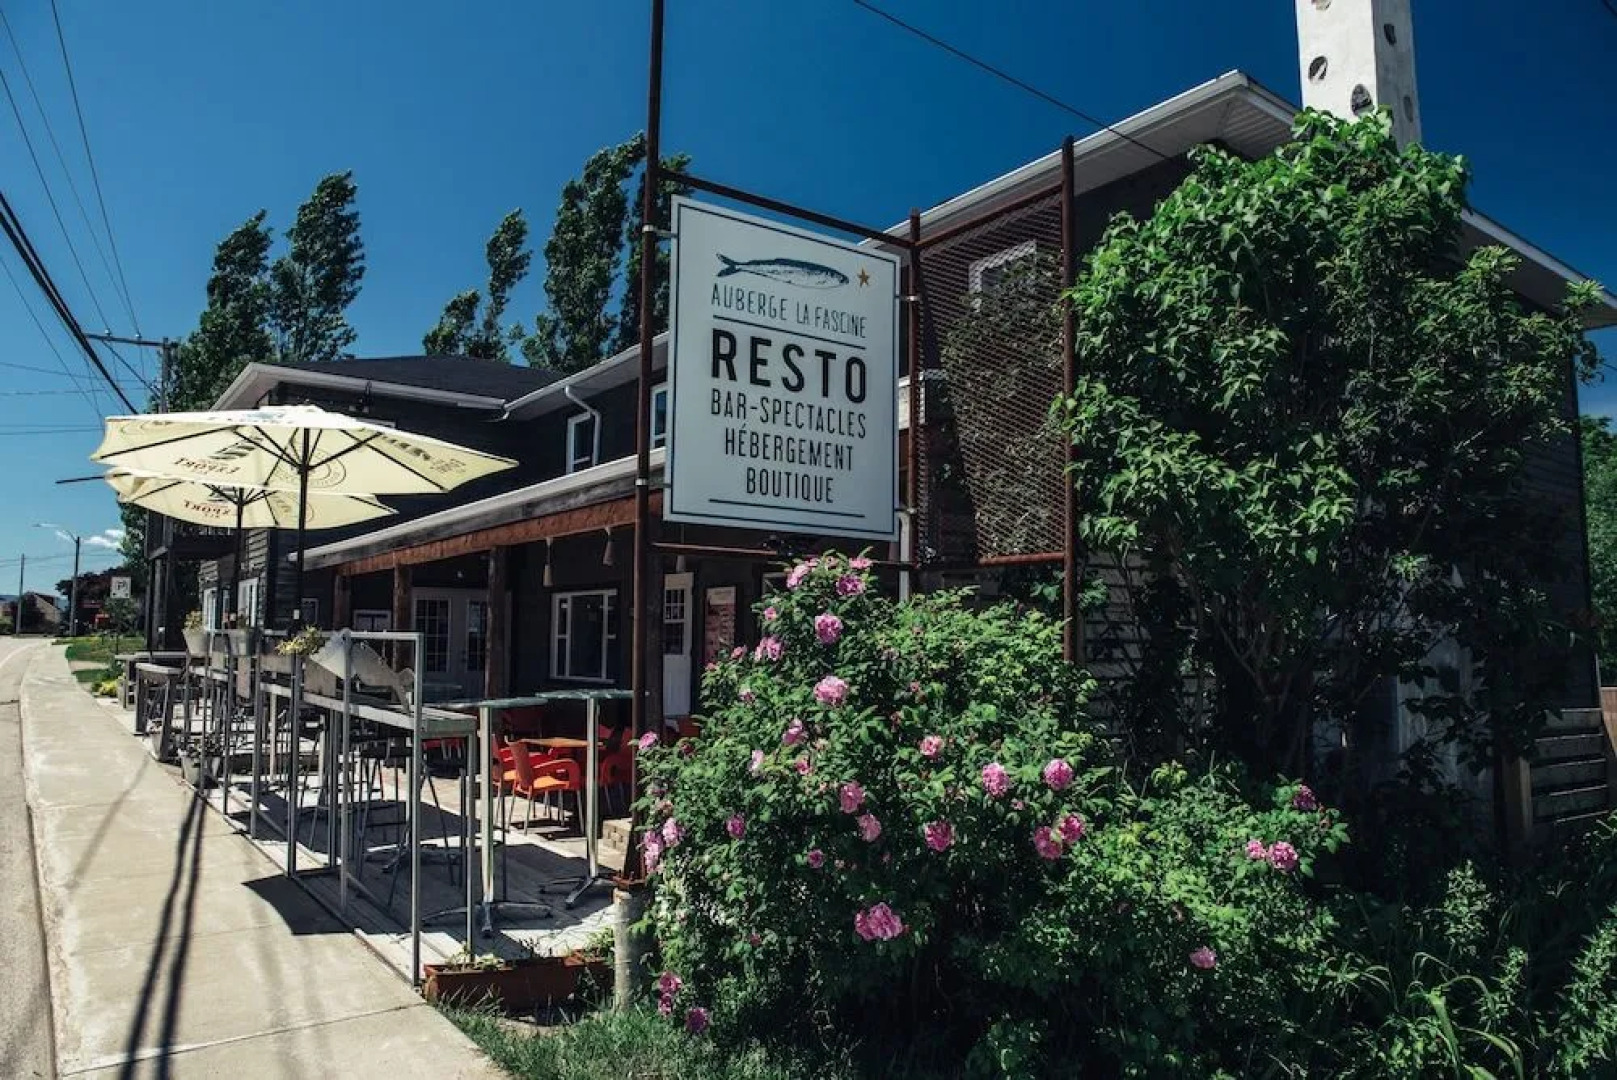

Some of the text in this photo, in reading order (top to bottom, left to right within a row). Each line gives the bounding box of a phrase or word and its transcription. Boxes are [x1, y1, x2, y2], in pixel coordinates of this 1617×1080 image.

[711, 283, 867, 339] AUBERGE LA FASCINE
[711, 327, 867, 404] RESTO
[711, 388, 867, 438] BAR-SPECTACLES
[725, 424, 854, 471] HÉBERGEMENT
[746, 467, 834, 504] BOUTIQUE
